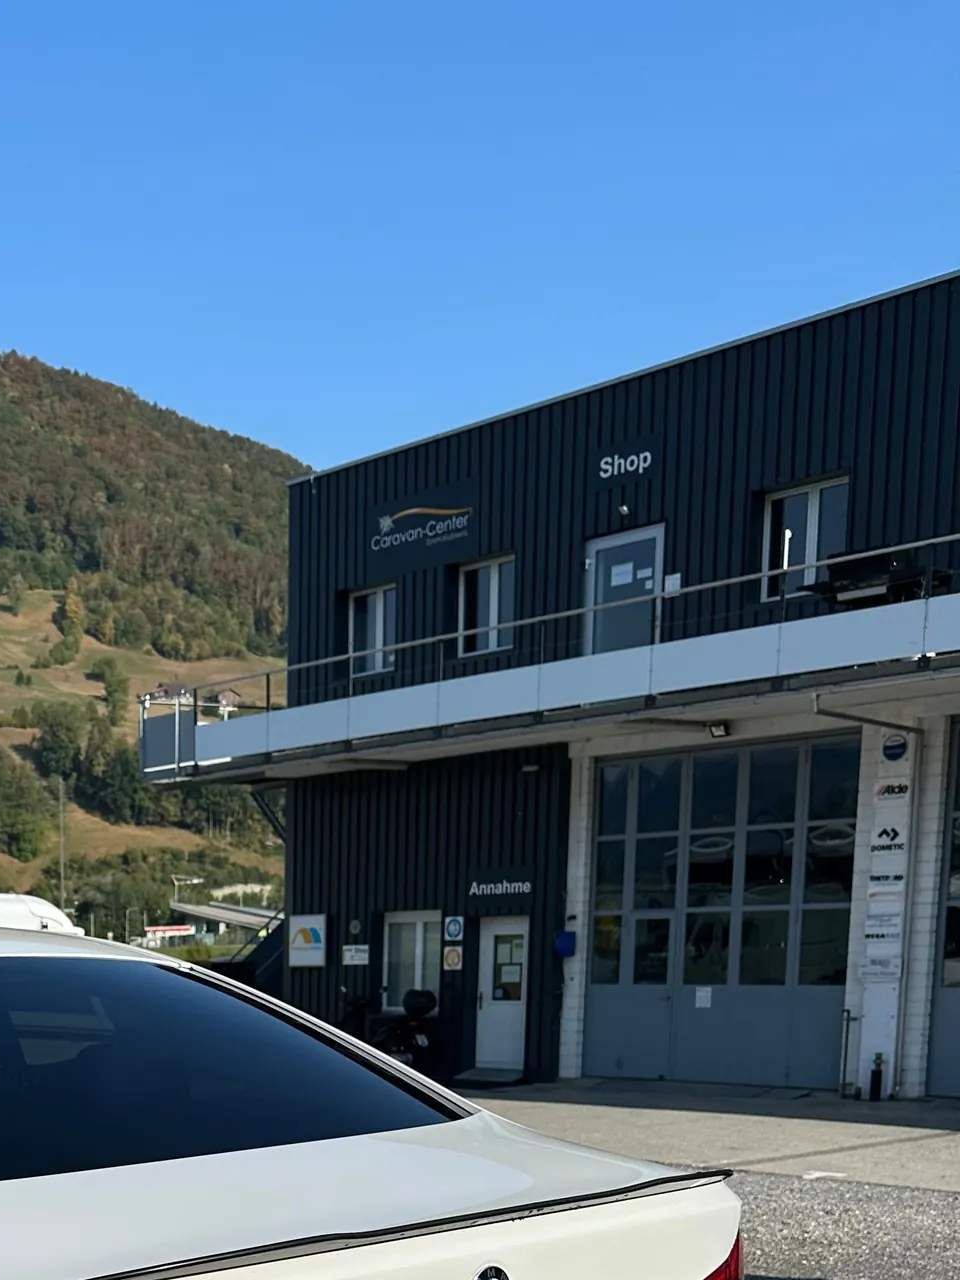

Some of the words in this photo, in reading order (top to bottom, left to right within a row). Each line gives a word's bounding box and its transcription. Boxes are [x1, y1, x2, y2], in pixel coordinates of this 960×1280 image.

[599, 451, 652, 479] Shop
[370, 515, 469, 551] Caravan-Center
[870, 843, 905, 853] DOMETIC
[468, 880, 532, 896] Annahme
